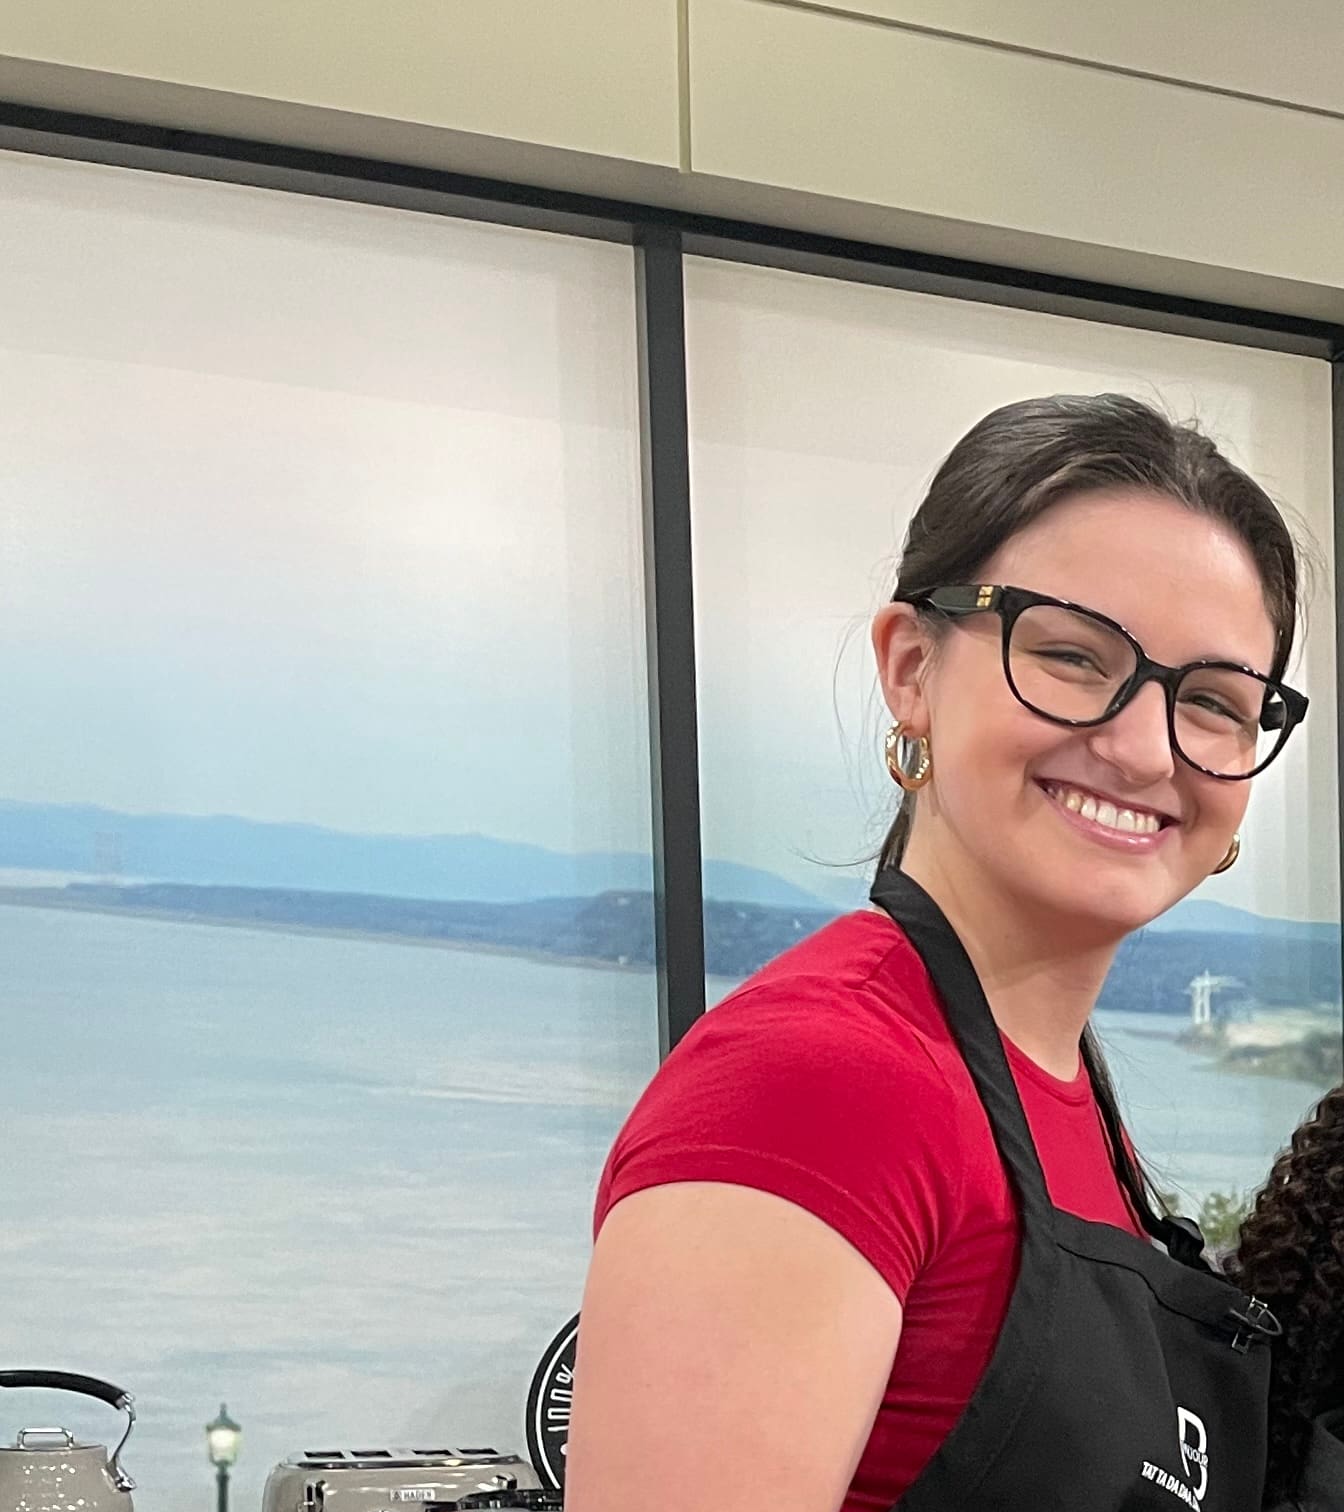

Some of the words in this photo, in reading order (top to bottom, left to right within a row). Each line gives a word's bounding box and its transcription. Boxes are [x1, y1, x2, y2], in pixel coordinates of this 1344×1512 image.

[1141, 1461, 1159, 1481] TAT
[1156, 1469, 1168, 1487] TA
[1165, 1475, 1180, 1494] DA
